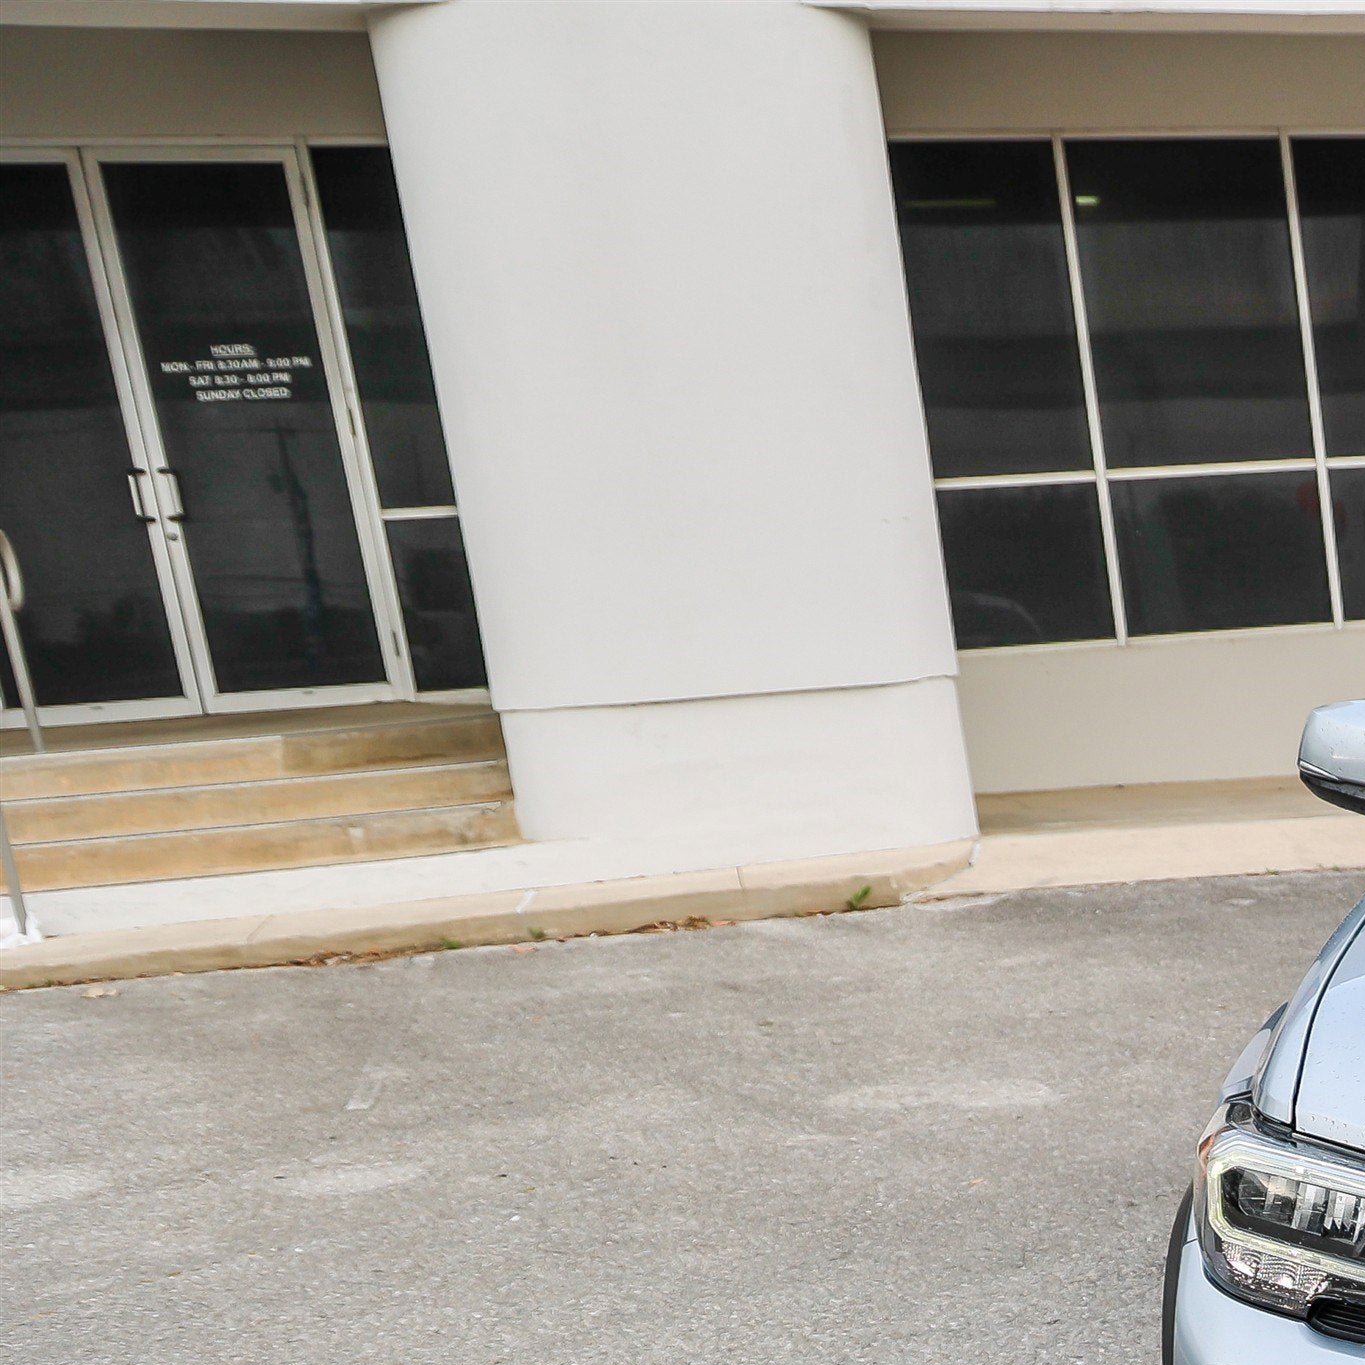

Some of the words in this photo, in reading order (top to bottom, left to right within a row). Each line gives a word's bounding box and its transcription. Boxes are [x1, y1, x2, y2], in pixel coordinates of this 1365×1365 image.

[195, 360, 215, 371] FRI
[291, 356, 312, 368] PM
[188, 375, 211, 387] SAT
[271, 372, 292, 384] PM
[196, 389, 241, 402] SUNDAY
[241, 387, 291, 400] CLOSED
